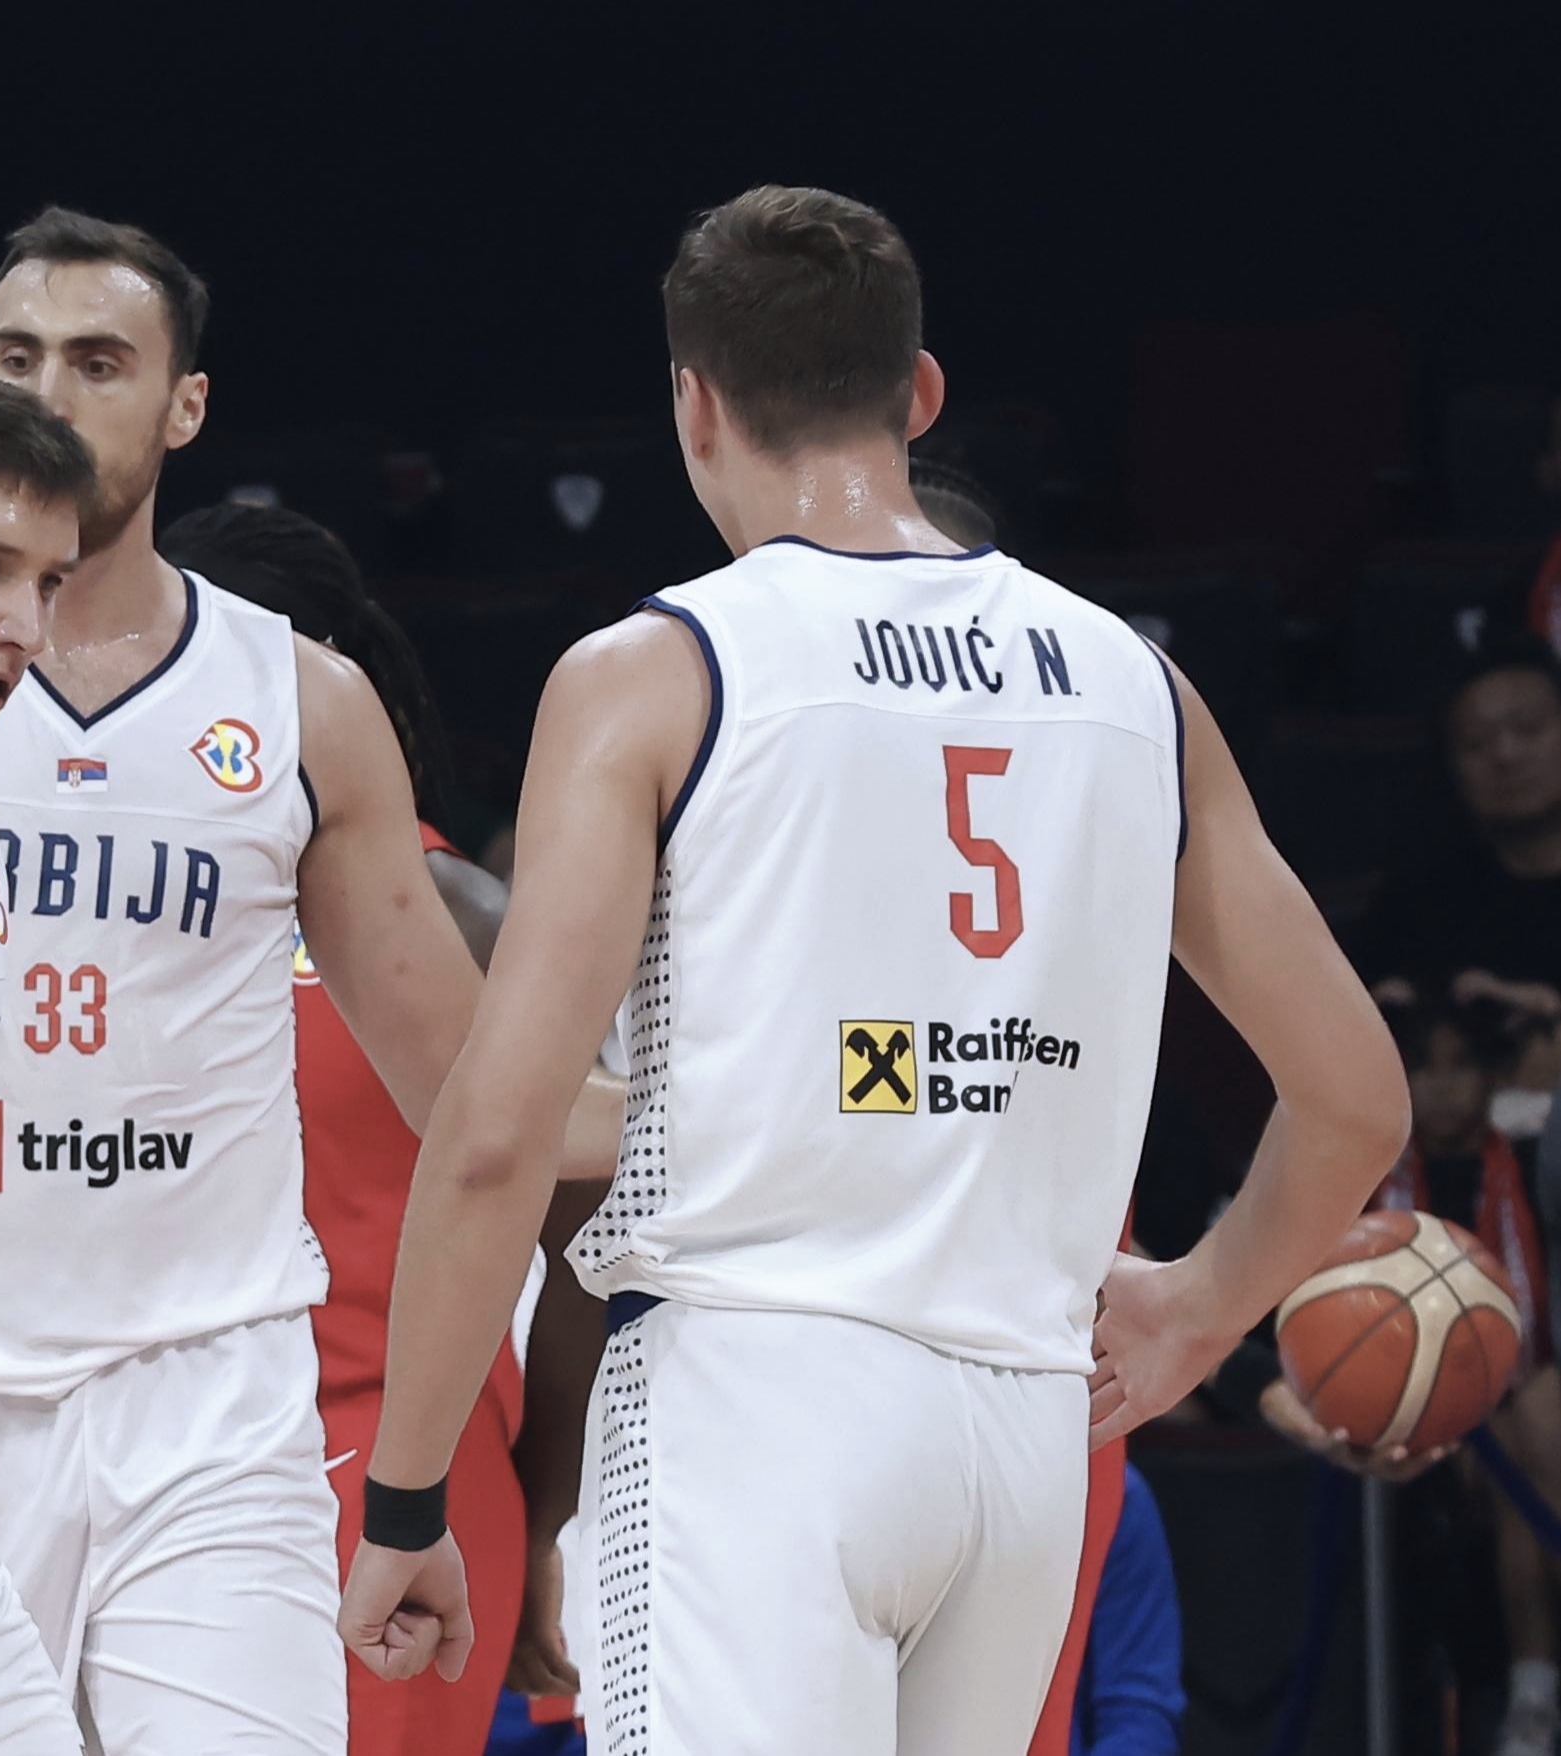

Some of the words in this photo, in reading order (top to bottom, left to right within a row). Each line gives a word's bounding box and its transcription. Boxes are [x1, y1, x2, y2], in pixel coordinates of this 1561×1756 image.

[1026, 628, 1082, 696] N.
[943, 745, 1024, 959] 5
[24, 963, 107, 1055] 33
[18, 1118, 193, 1188] triglav
